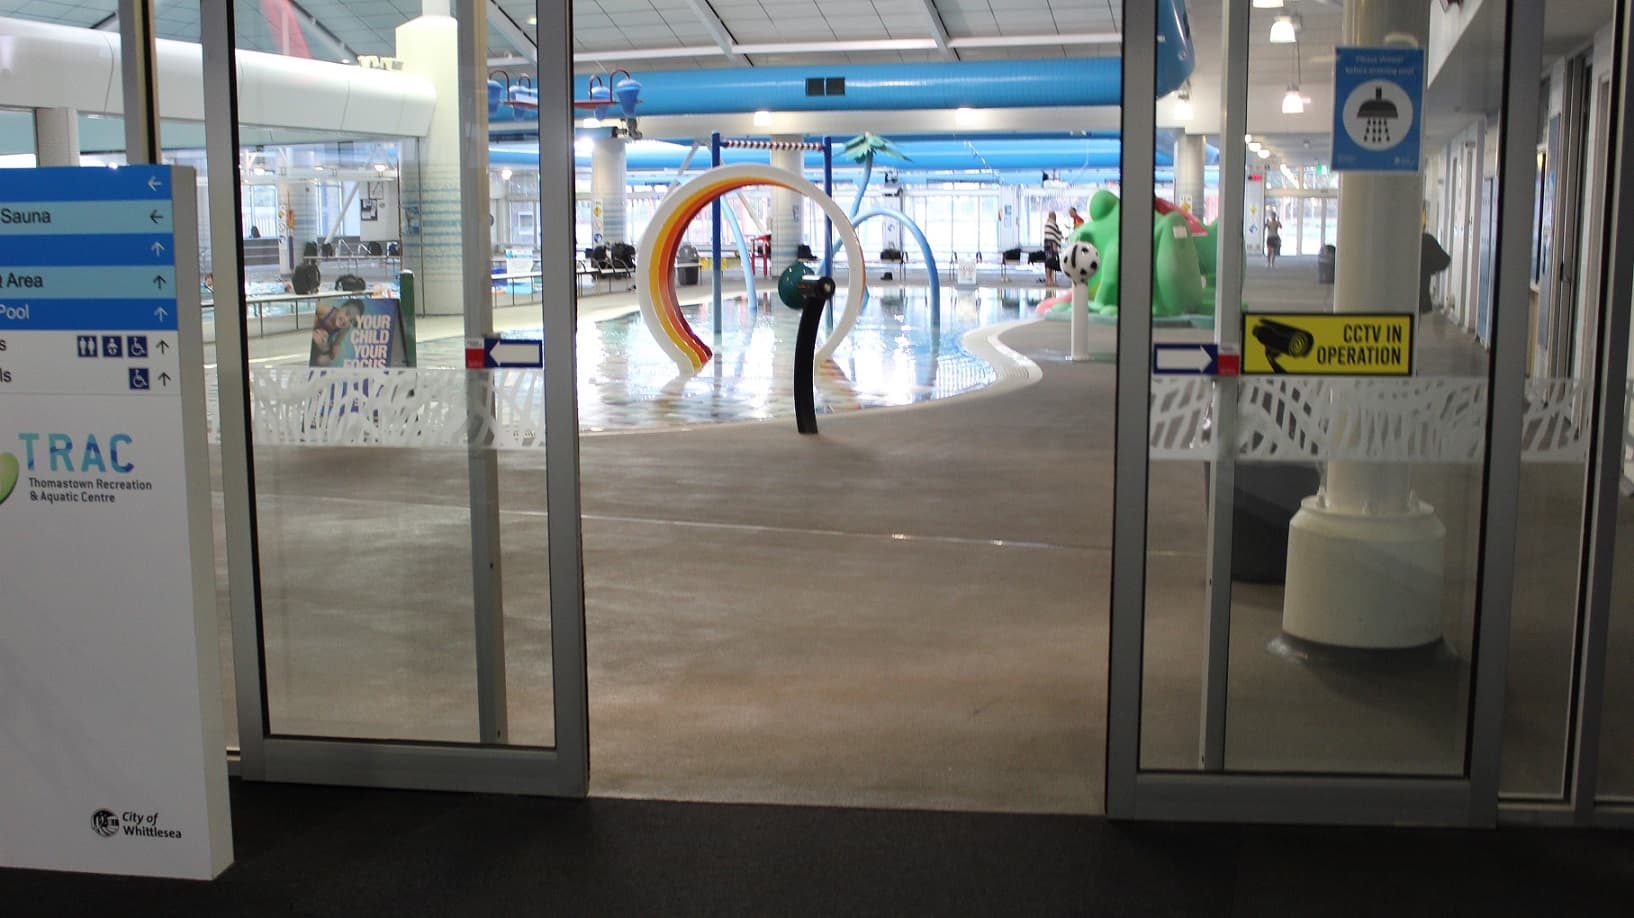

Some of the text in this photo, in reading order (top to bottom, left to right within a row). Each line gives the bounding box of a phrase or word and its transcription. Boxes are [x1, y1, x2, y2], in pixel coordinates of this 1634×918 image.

[1, 208, 51, 224] Sauna
[7, 272, 44, 288] Area
[0, 303, 30, 320] Pool
[356, 314, 391, 329] YOUR
[350, 330, 389, 344] CHILD
[1343, 324, 1402, 344] CCTV IN
[354, 345, 388, 359] YOUR
[1316, 346, 1401, 365] OPERATION
[18, 433, 135, 473] TRAC
[28, 477, 152, 491] Thomastown Recreation
[30, 491, 115, 504] & Aquatic Centre
[122, 811, 159, 826] City of
[123, 826, 182, 839] Whittlesea
